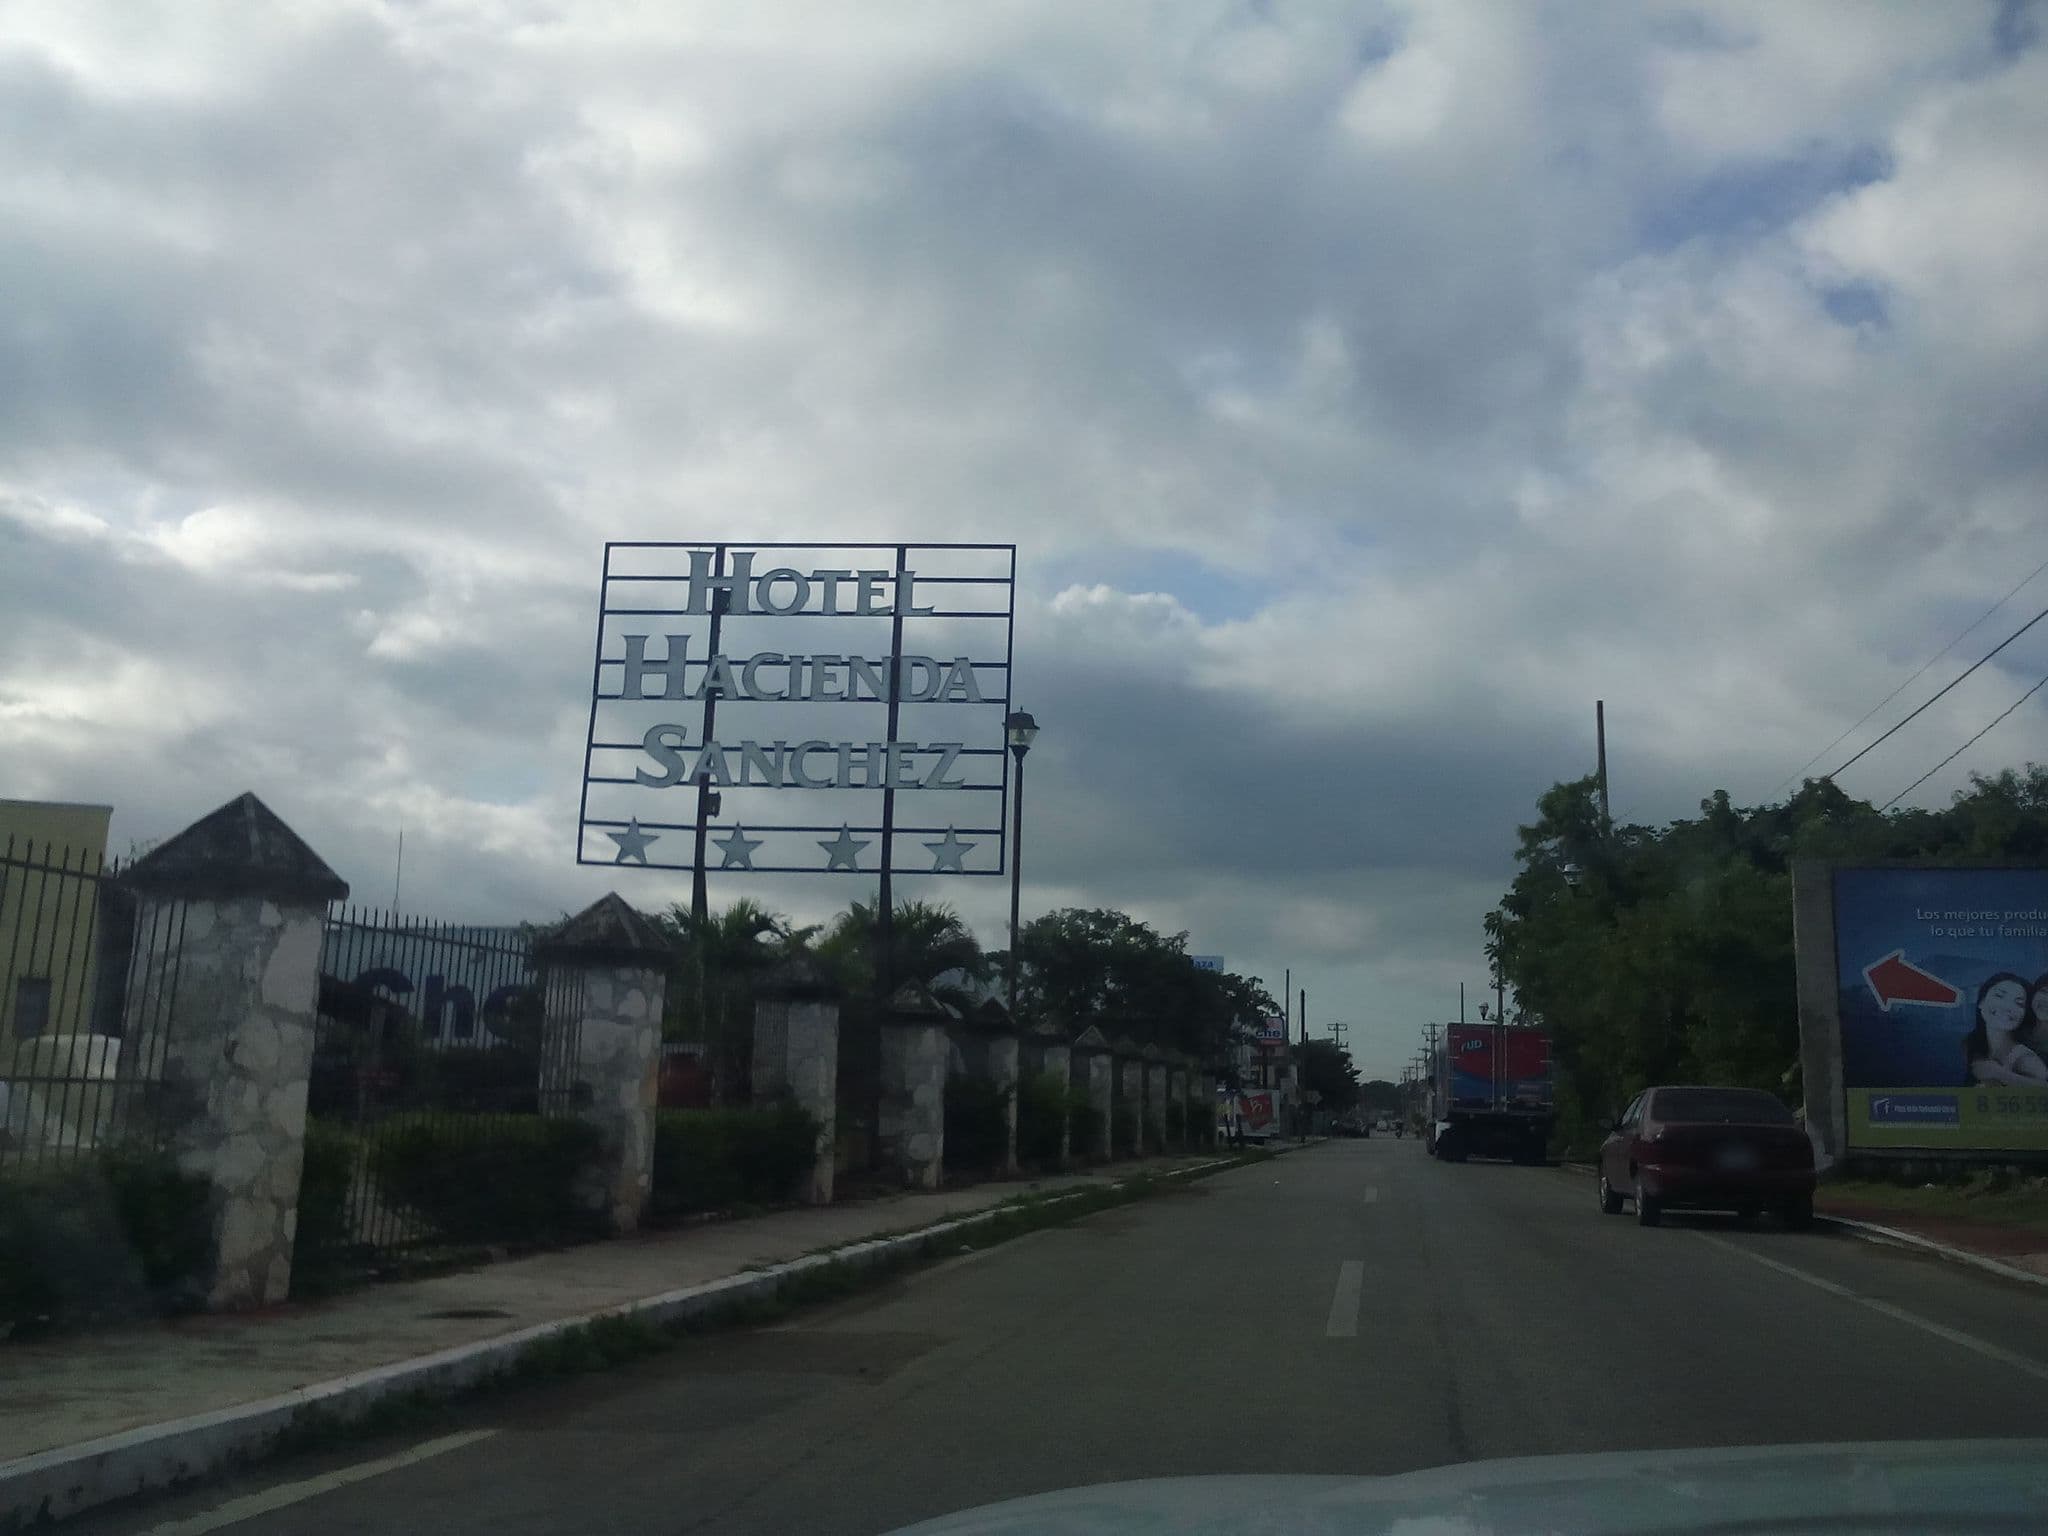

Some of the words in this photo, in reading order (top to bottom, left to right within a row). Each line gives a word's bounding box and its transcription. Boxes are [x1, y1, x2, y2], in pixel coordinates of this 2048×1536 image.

[683, 550, 935, 616] HOTEL
[620, 634, 985, 703] HACIENDA
[635, 724, 966, 790] SANCHEZ
[1916, 908, 1939, 920] Los
[1944, 908, 2000, 922] mejores
[2004, 908, 2048, 922] produ
[1931, 924, 1944, 936] lo
[1947, 927, 1975, 939] que
[1979, 926, 1994, 937] tu
[1191, 959, 1214, 969] laza
